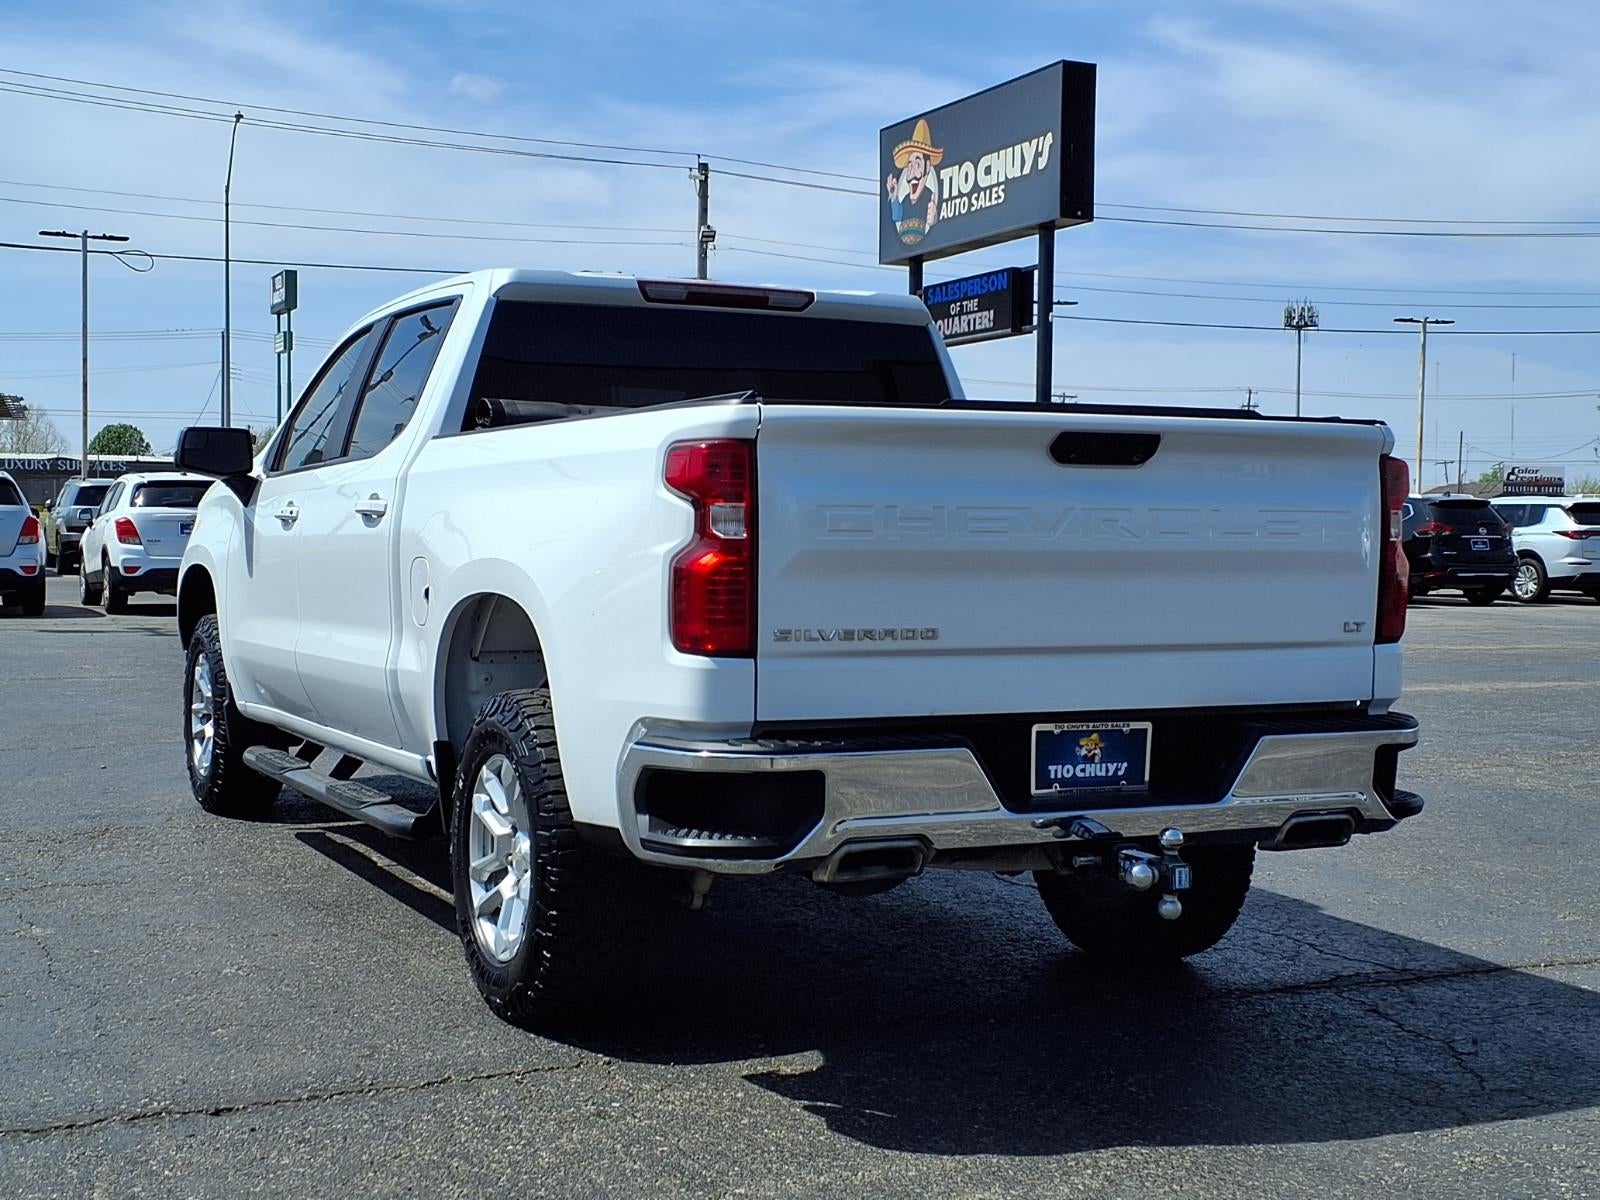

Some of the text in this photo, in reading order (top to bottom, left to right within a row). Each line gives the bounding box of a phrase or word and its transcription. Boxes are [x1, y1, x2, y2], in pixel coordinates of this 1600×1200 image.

[940, 131, 1053, 199] TIO CHUY'S
[939, 185, 1005, 220] AUTO SALES
[927, 271, 1008, 304] SALESPERSON
[949, 298, 979, 316] OF THE
[936, 309, 994, 338] QUARTER!
[1511, 466, 1540, 475] Color
[816, 504, 1351, 542] CHEVROLET
[773, 628, 940, 642] SILVERADO
[1343, 621, 1366, 633] LT
[1048, 762, 1128, 779] TIO CHUY'S
